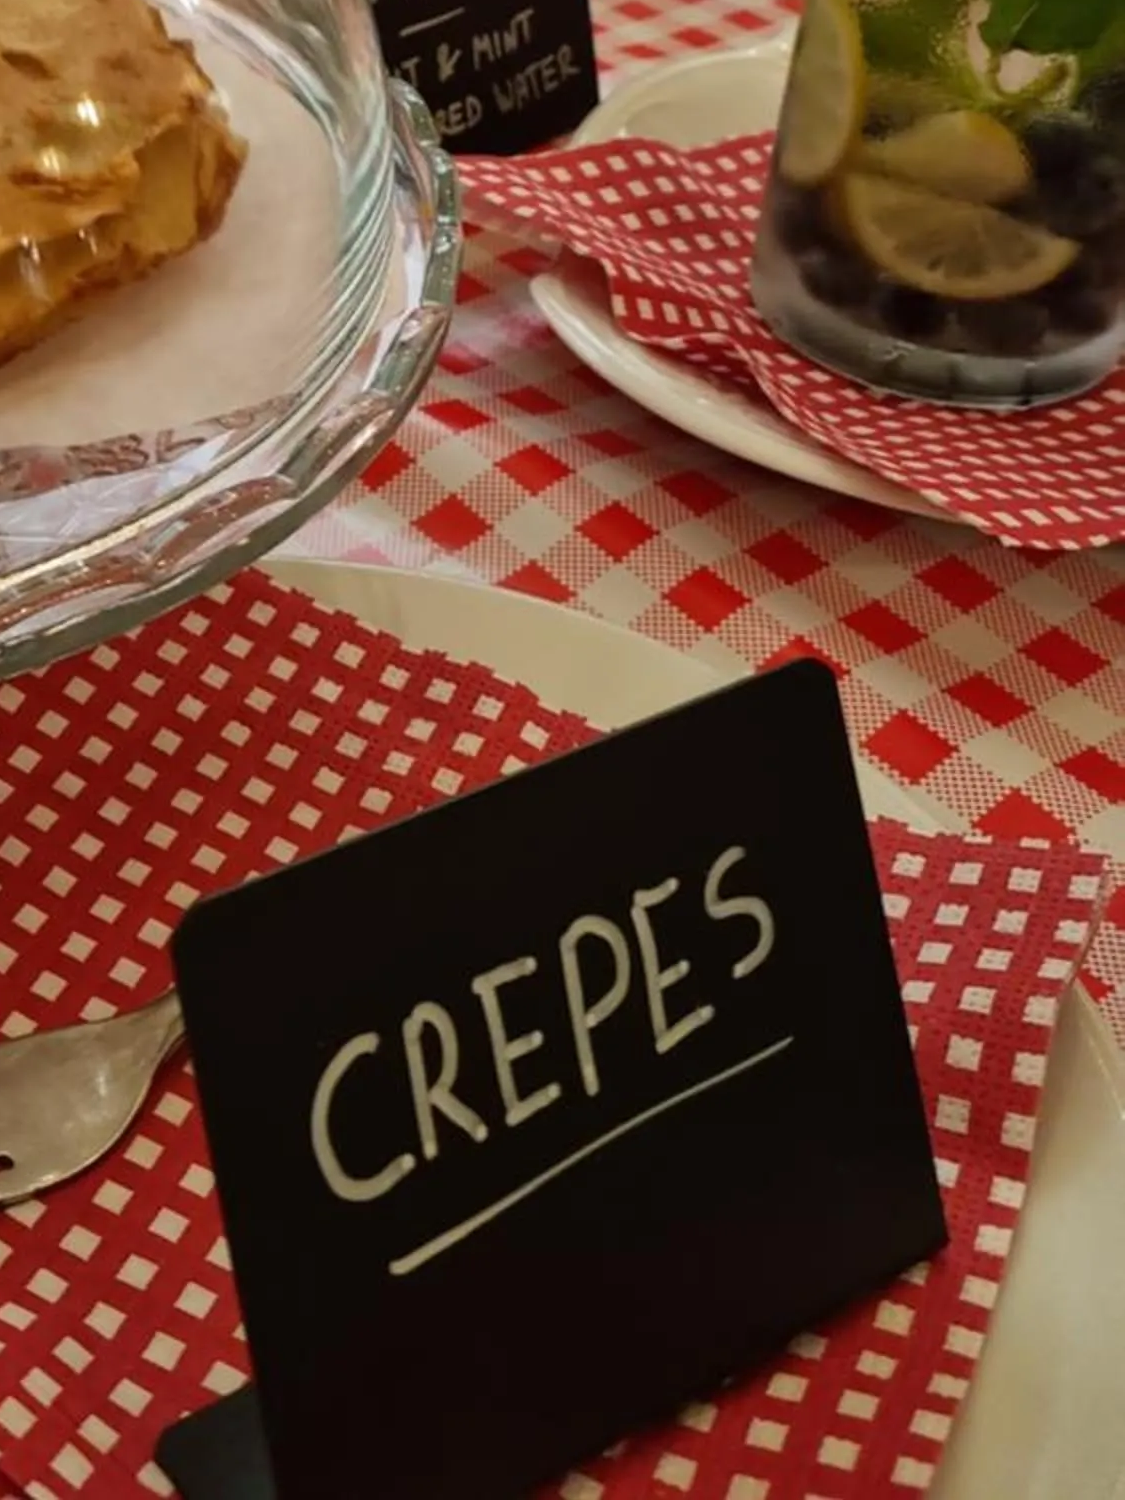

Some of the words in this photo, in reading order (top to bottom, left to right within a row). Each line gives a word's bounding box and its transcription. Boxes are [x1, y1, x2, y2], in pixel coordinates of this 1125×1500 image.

[472, 9, 534, 69] MINT
[435, 95, 483, 135] RED
[493, 45, 580, 113] WATER
[311, 846, 775, 1201] CREPES
